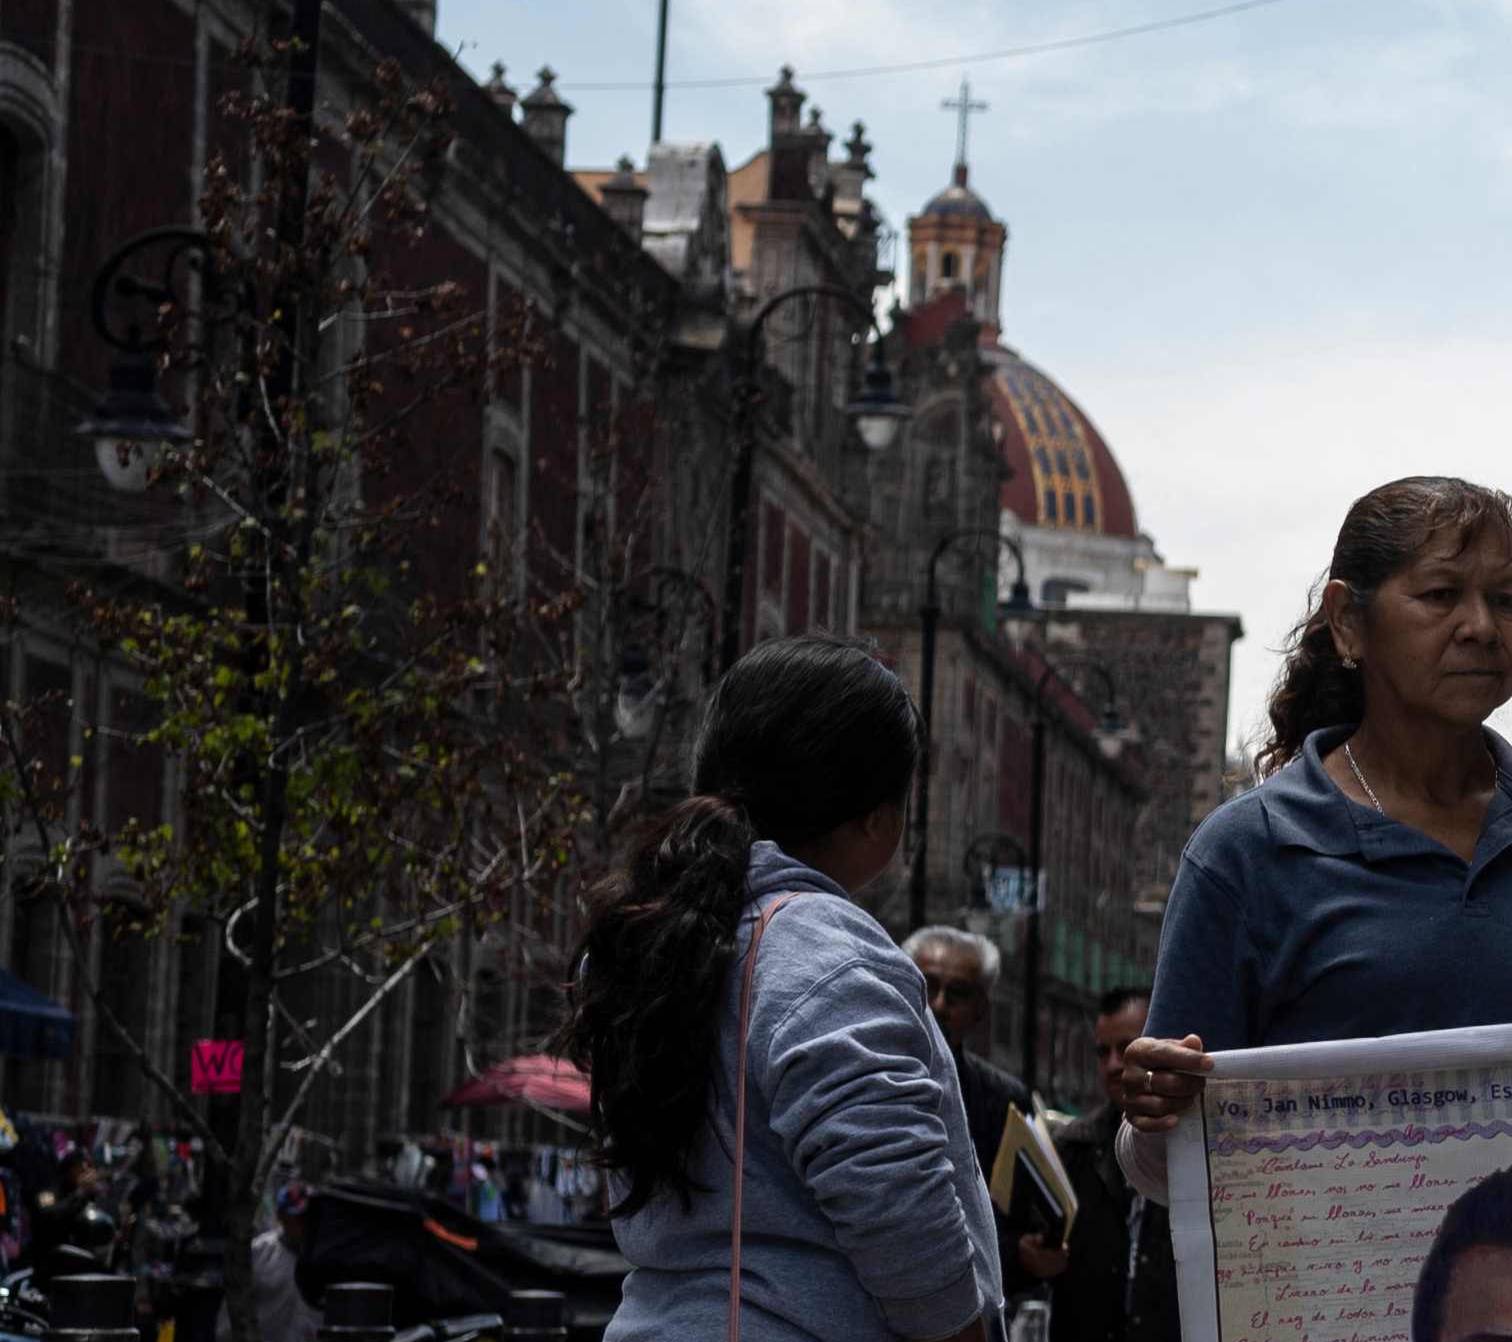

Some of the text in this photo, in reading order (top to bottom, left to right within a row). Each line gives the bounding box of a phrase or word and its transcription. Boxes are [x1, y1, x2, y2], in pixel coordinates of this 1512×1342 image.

[1216, 1101, 1249, 1118] Yo,
[1263, 1098, 1297, 1113] Jan
[1308, 1093, 1375, 1110] Nimmo,
[1387, 1088, 1476, 1108] Glasgow,
